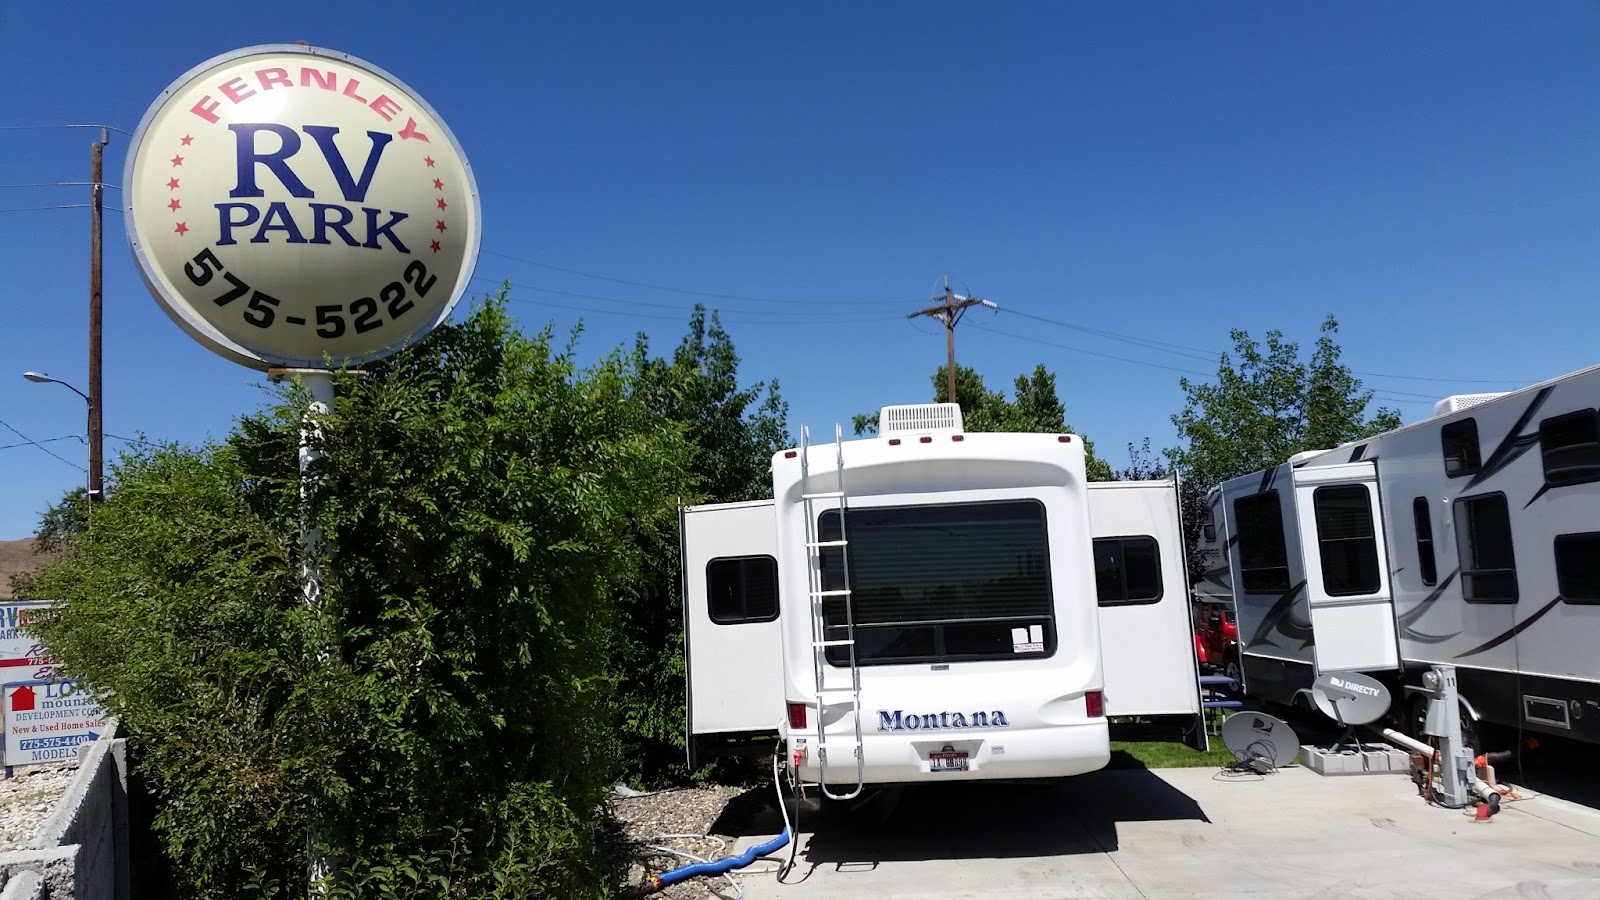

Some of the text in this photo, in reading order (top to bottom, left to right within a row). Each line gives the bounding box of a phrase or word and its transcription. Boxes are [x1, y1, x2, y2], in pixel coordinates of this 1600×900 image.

[190, 67, 430, 143] FERNLEY
[228, 123, 393, 203] RV
[214, 202, 411, 254] PARK
[184, 247, 437, 339] 575-5222
[0, 629, 19, 640] ARK
[1345, 681, 1380, 697] DIRECTV
[1446, 677, 1456, 688] 11
[16, 708, 80, 722] DEVELOPMENT
[876, 709, 1010, 733] Montana
[12, 719, 106, 735] New & Used Home Sales
[21, 735, 90, 750] 775-575-4400
[32, 747, 78, 761] MODELS
